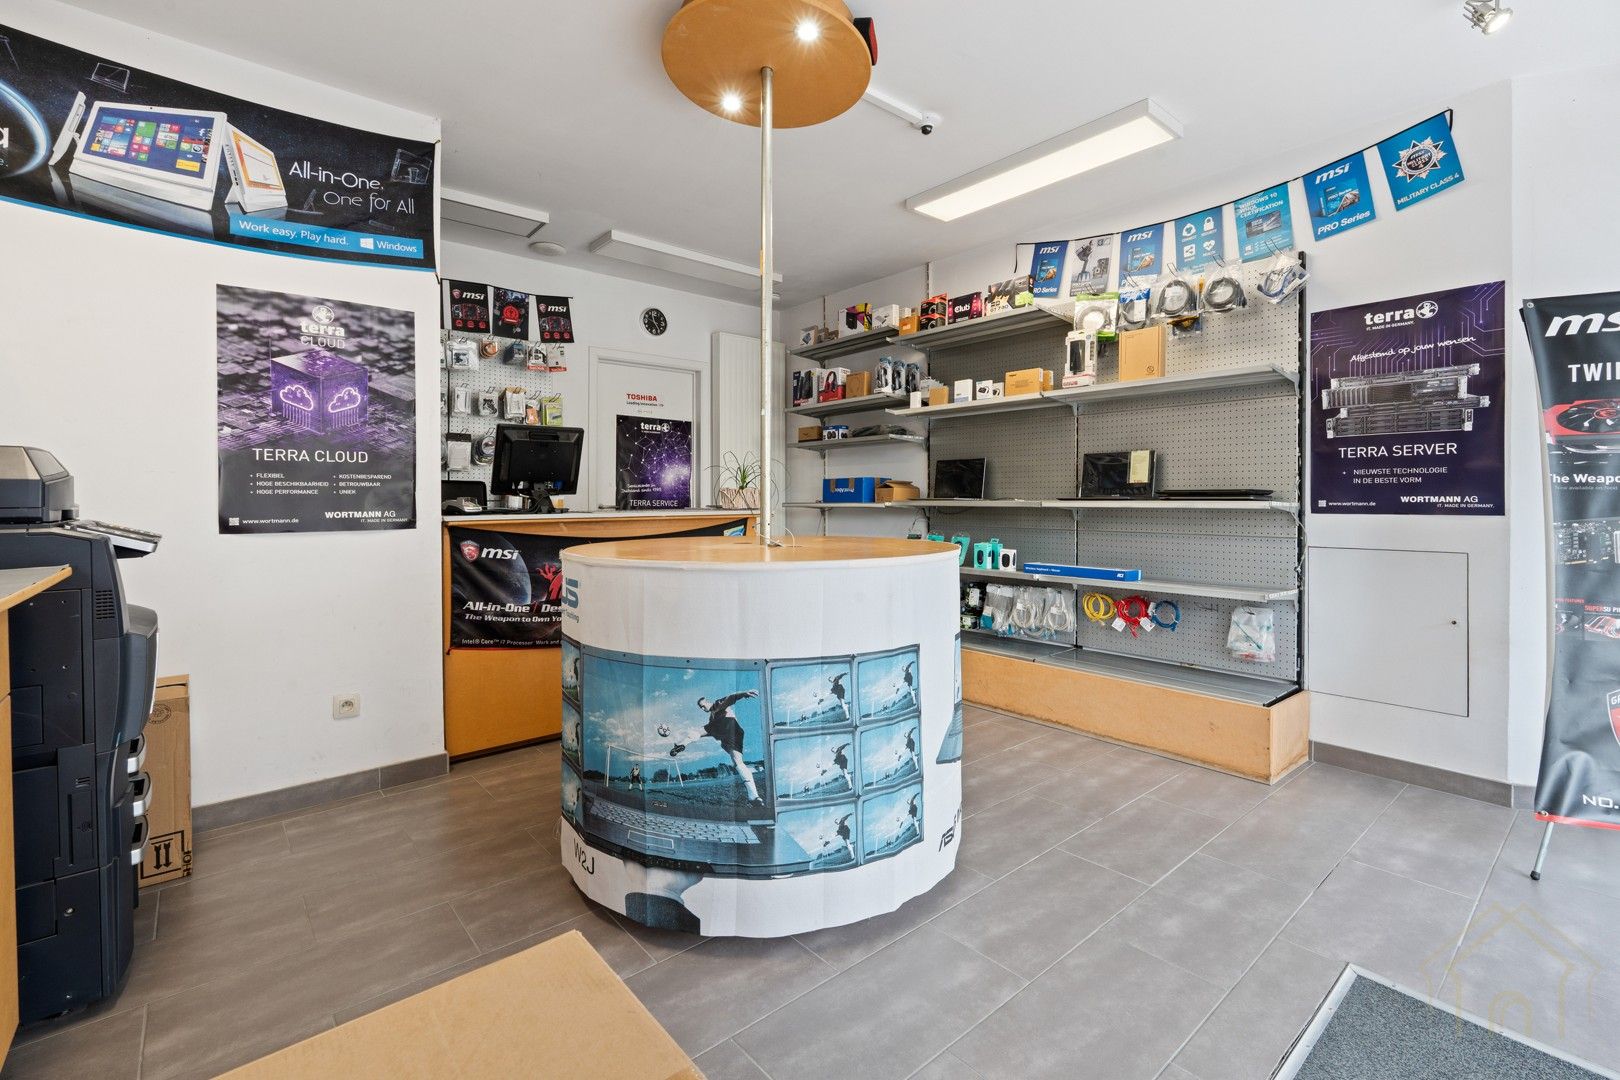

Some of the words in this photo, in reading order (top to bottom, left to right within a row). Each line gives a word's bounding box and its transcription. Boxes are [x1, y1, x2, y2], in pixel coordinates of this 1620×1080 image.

[288, 160, 384, 190] All-in-One.
[1315, 162, 1350, 185] msi
[1397, 186, 1429, 205] MILITARY
[1430, 174, 1454, 190] CLASS
[323, 191, 363, 207] One
[368, 192, 392, 213] for
[396, 199, 415, 214] All
[1240, 195, 1269, 210] WINDOWS
[1240, 200, 1284, 218] CERTIFICATION
[1317, 221, 1339, 235] PRO
[1340, 210, 1371, 226] Series
[239, 220, 270, 233] Work
[272, 226, 297, 238] easy.
[300, 231, 321, 242] Play
[324, 234, 349, 245] hard.
[1127, 230, 1153, 243] msi
[376, 240, 417, 253] Windows
[1040, 246, 1060, 254] msi
[462, 291, 485, 300] msi
[547, 305, 567, 313] msi
[1364, 308, 1415, 325] terra
[300, 320, 344, 337] terra
[300, 335, 345, 349] CLOUD
[1351, 348, 1396, 362] Afgestemd
[1398, 347, 1411, 355] op
[1411, 343, 1435, 353] jouw
[1437, 336, 1476, 347] wensen
[626, 393, 657, 402] TOSHIBA
[640, 422, 661, 431] terra
[252, 448, 310, 462] TERRA
[314, 450, 368, 463] CLOUD
[1338, 446, 1389, 459] TERRA
[1392, 443, 1457, 457] SERVER
[1353, 467, 1391, 475] NIEUWSTE
[1392, 466, 1448, 475] TECHNOLOGIE
[1399, 476, 1422, 484] VORM
[630, 499, 651, 507] TERRA
[652, 499, 678, 507] SERVICE
[1463, 495, 1478, 503] AG
[383, 510, 396, 518] AG
[481, 547, 518, 560] msi
[463, 601, 531, 613] All-in-One
[484, 614, 520, 623] Weapon
